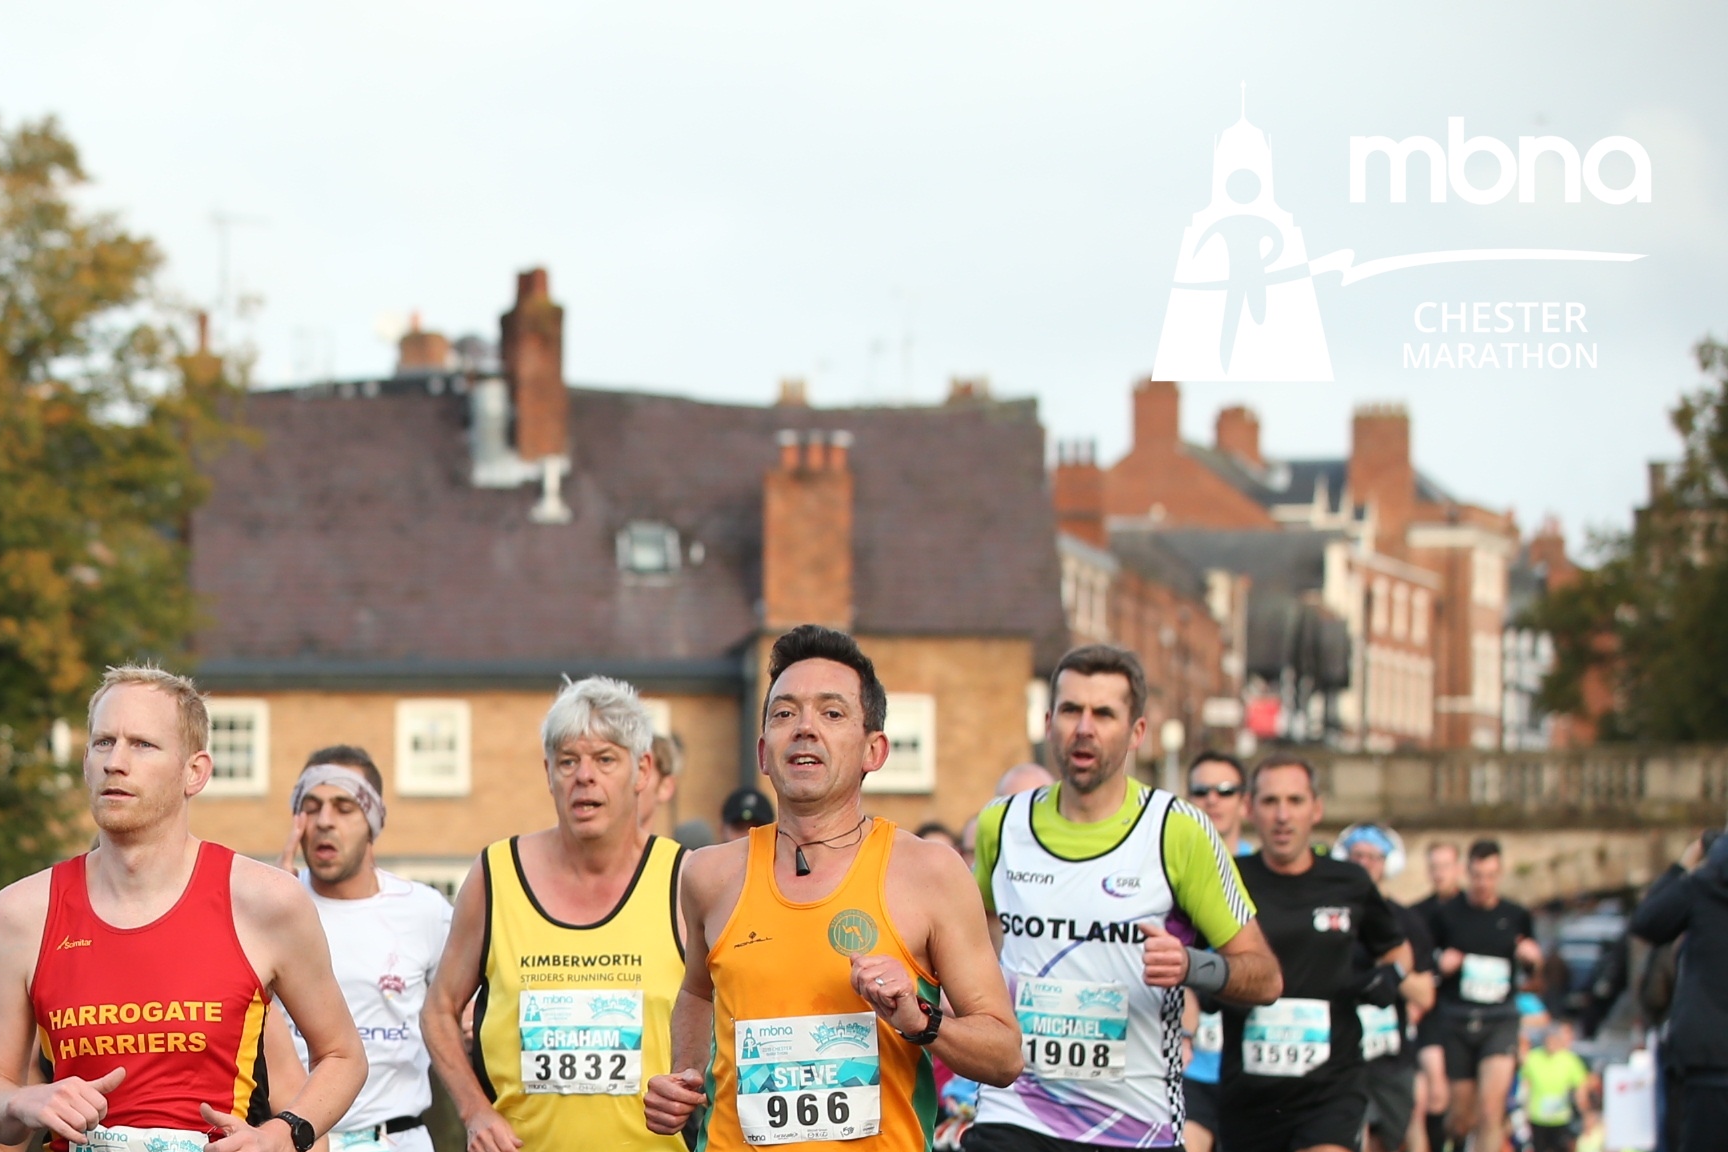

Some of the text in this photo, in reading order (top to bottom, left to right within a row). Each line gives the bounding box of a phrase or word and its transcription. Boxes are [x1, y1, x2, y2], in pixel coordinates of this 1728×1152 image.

[999, 913, 1148, 944] SCOTLAND
[520, 954, 642, 968] KIMBERWORTH
[520, 973, 642, 983] STRIDERS RUNNING CLUB
[543, 995, 573, 1004] mbna
[48, 1001, 222, 1031] HARROGATE
[1033, 1015, 1105, 1038] MICHAEL
[543, 1029, 620, 1048] GRAHAM
[759, 1025, 793, 1037] mbna
[60, 1032, 207, 1060] HARRIERS
[1027, 1038, 1110, 1068] 1908
[535, 1053, 627, 1081] 3832
[774, 1064, 839, 1088] STEVE
[767, 1091, 850, 1128] 966
[94, 1130, 128, 1142] mbna
